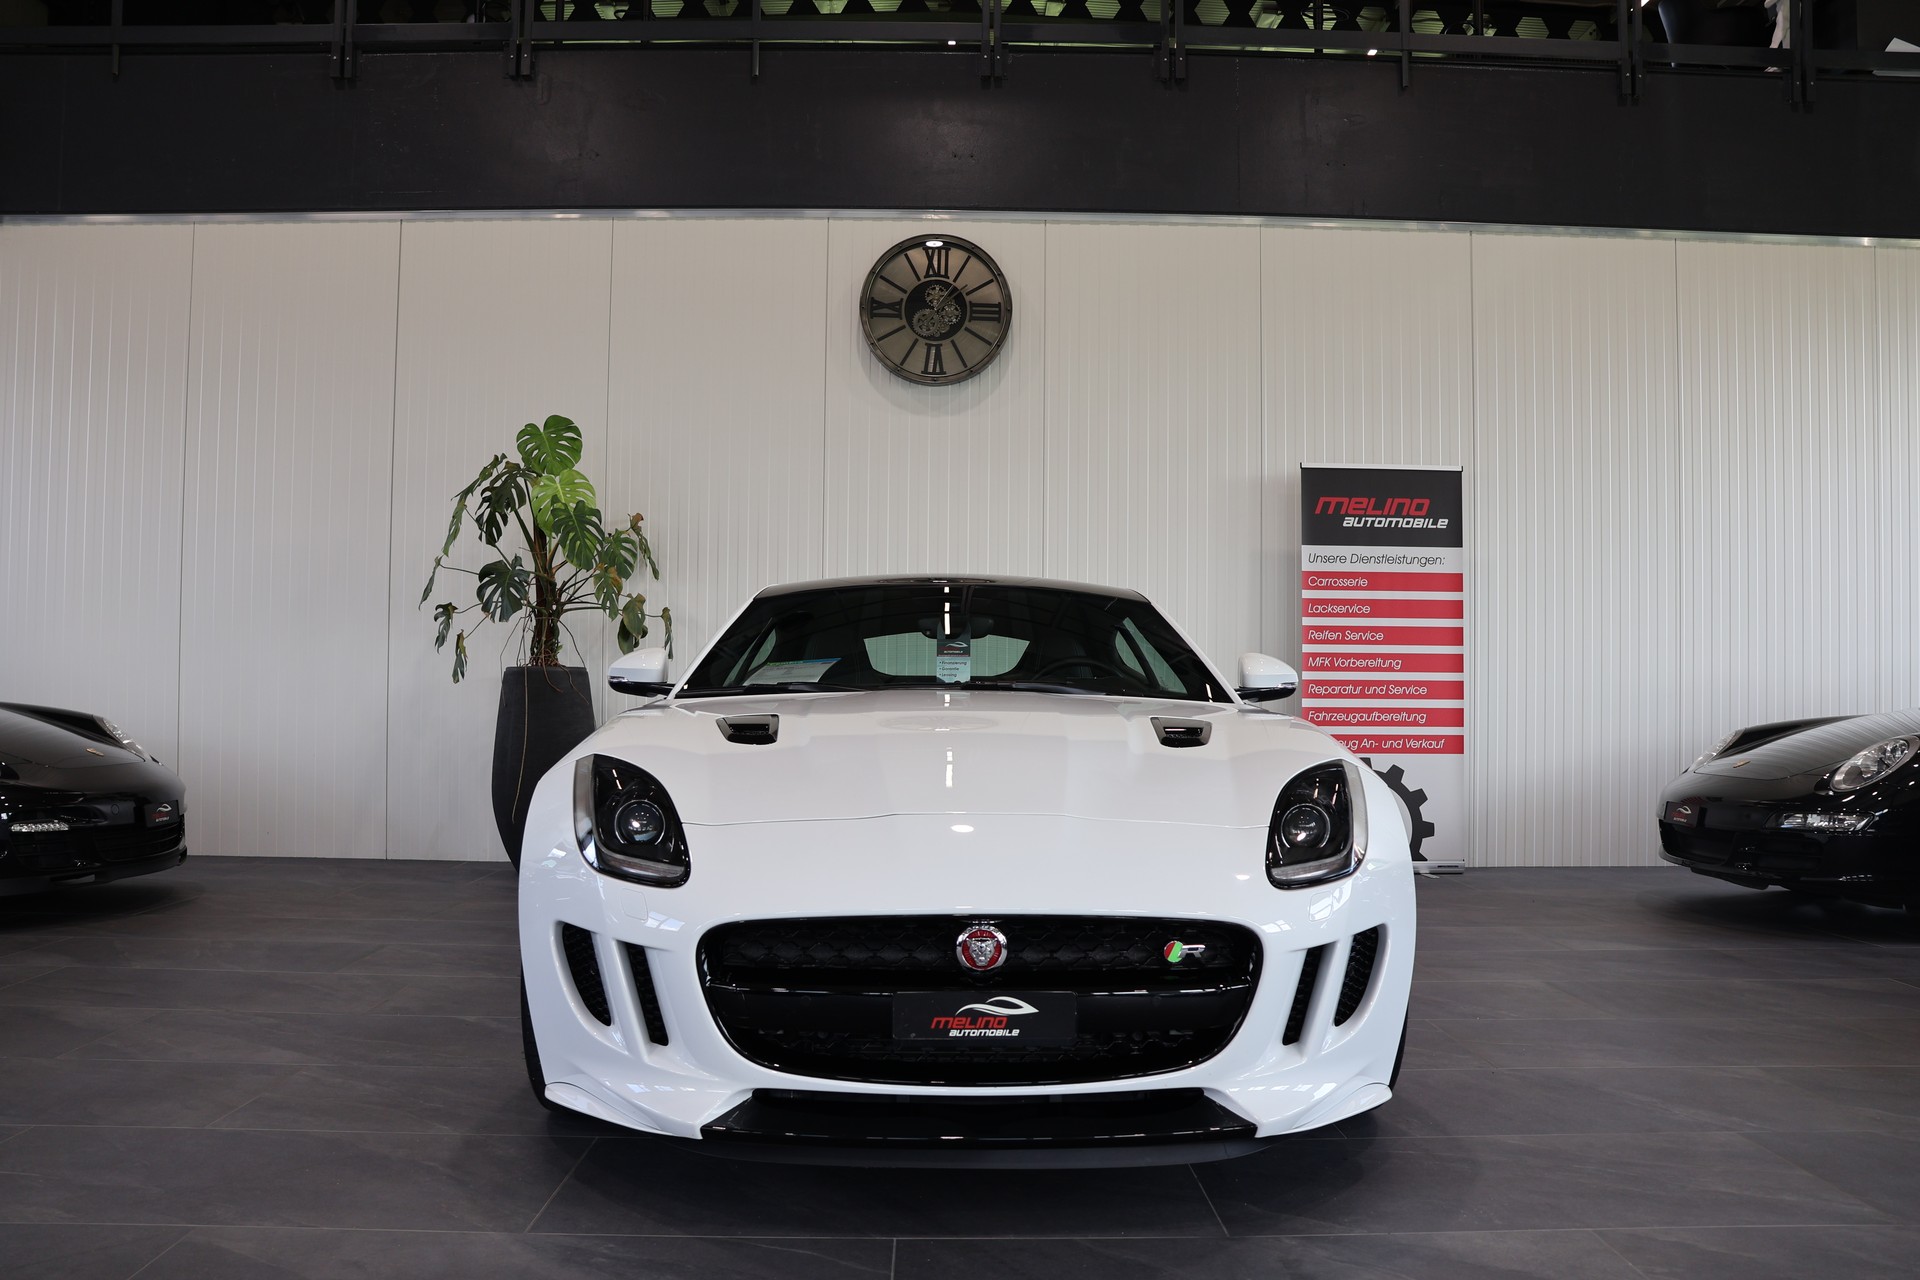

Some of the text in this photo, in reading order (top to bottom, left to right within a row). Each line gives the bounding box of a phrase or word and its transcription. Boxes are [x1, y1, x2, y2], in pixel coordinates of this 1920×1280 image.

[922, 246, 952, 279] XII
[1314, 496, 1431, 516] MELINO
[1342, 516, 1449, 529] AUTOMOBILE
[1308, 553, 1446, 567] Unsere Dienstleistungen:
[1308, 576, 1368, 587] Carrosserie
[1308, 603, 1371, 614] Lackservice
[1308, 630, 1384, 641] Reifen Service
[1308, 657, 1402, 670] MFK Vorbereitung
[1308, 684, 1428, 696] Reparatur und Service
[1308, 711, 1427, 724] Fahrzeugaufbereitung
[1360, 738, 1379, 749] An-
[1381, 738, 1403, 749] und
[1405, 738, 1446, 749] Verkauf
[930, 1017, 1008, 1029] MELINO
[949, 1029, 1020, 1037] AUTOMOBILE
